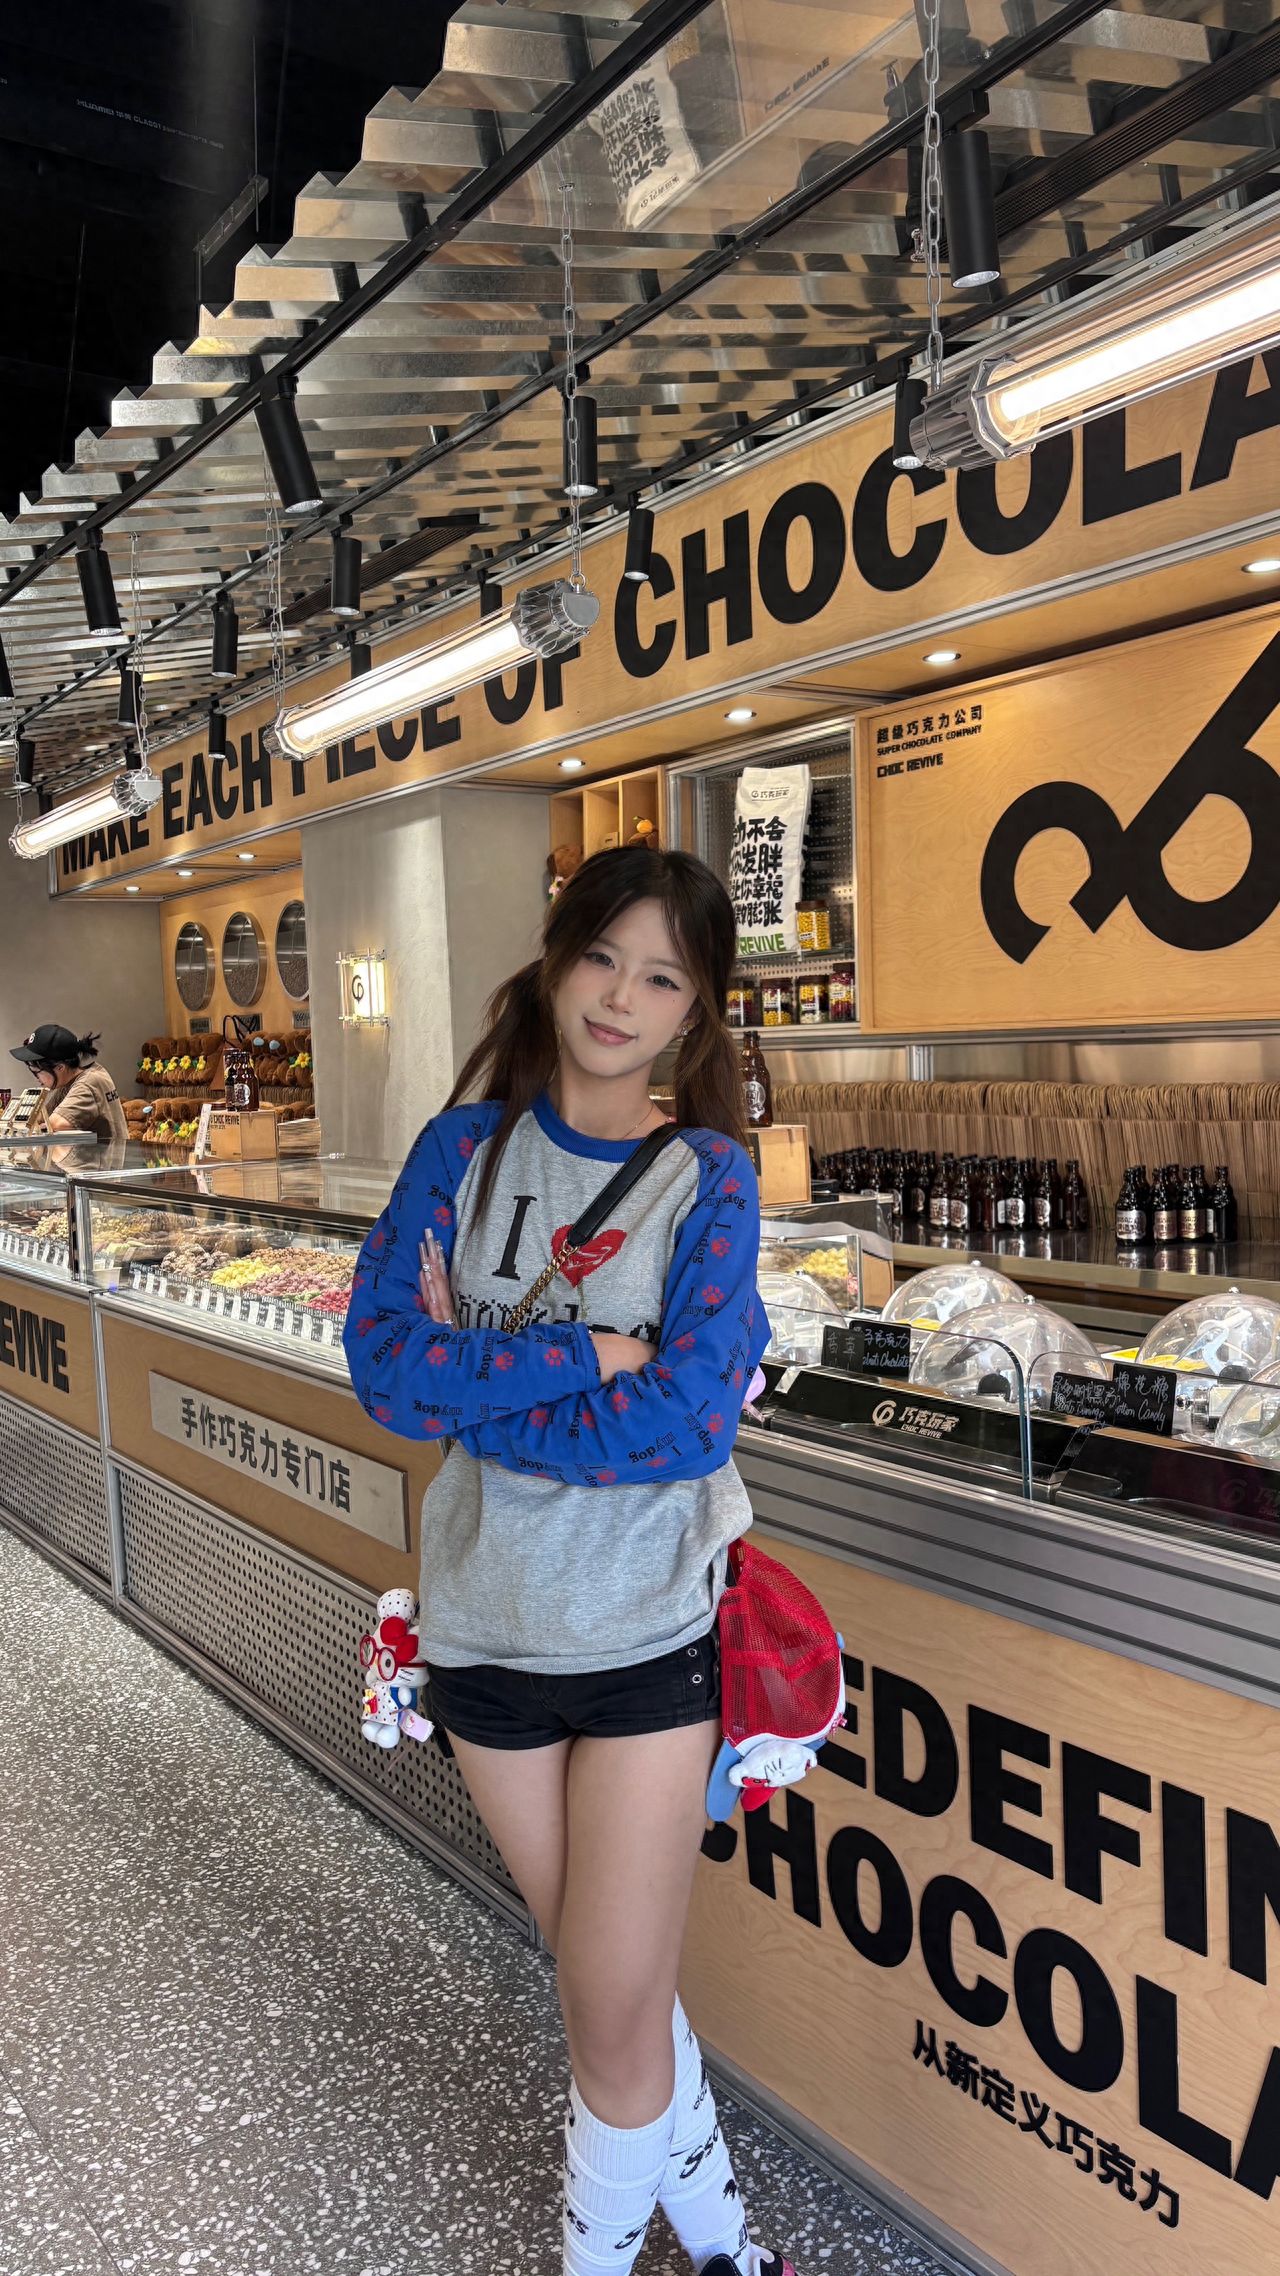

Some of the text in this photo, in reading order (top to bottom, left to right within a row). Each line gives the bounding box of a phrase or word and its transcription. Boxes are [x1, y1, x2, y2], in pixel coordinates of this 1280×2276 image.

[876, 704, 983, 744] 超级巧克力公司
[876, 724, 983, 757] SUPER CHOCOLATE COMPANY
[876, 753, 944, 778] CHOC REVIVE
[163, 727, 273, 840] EACH
[492, 1195, 538, 1281] I
[181, 1396, 351, 1514] 手作巧克力专门店
[898, 1406, 960, 1432] 巧克玩家
[700, 1787, 1280, 2200] HOCOL
[912, 2018, 1180, 2229] 从新定义巧克力
